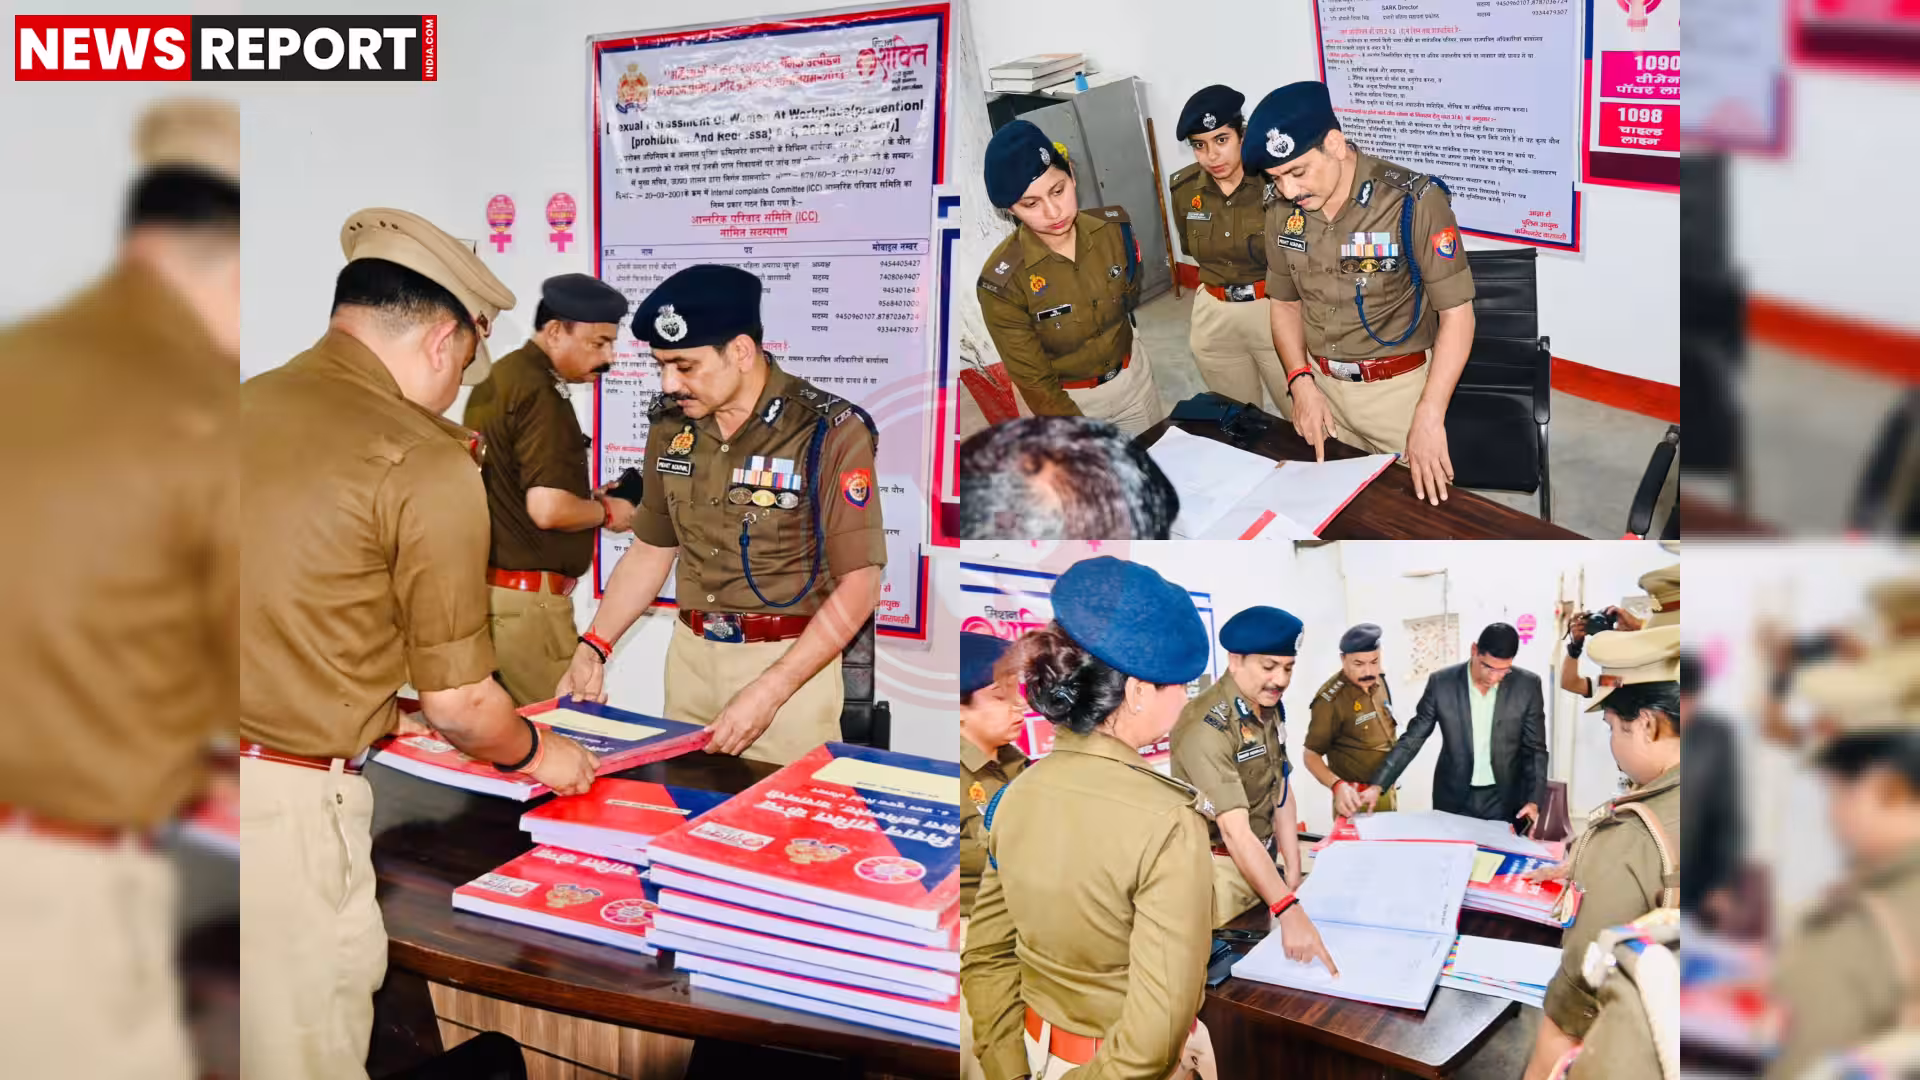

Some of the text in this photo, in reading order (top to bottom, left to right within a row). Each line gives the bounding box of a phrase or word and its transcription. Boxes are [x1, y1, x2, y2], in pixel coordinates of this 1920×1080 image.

[1634, 55, 1680, 71] 1090
[1617, 107, 1663, 124] 1098
[606, 121, 643, 135] [exual
[693, 131, 714, 143] And
[711, 187, 734, 196] Internal
[735, 186, 769, 197] complaints
[771, 184, 805, 195] Committee
[806, 183, 823, 194] (ICC)
[730, 211, 761, 225] परिवाद
[764, 210, 792, 223] समिति
[795, 209, 819, 224] (ICC)
[879, 259, 921, 268] 9454405427
[879, 273, 921, 282] 7408069407
[877, 325, 919, 334] 9334479307
[984, 605, 1019, 620] मिशन
